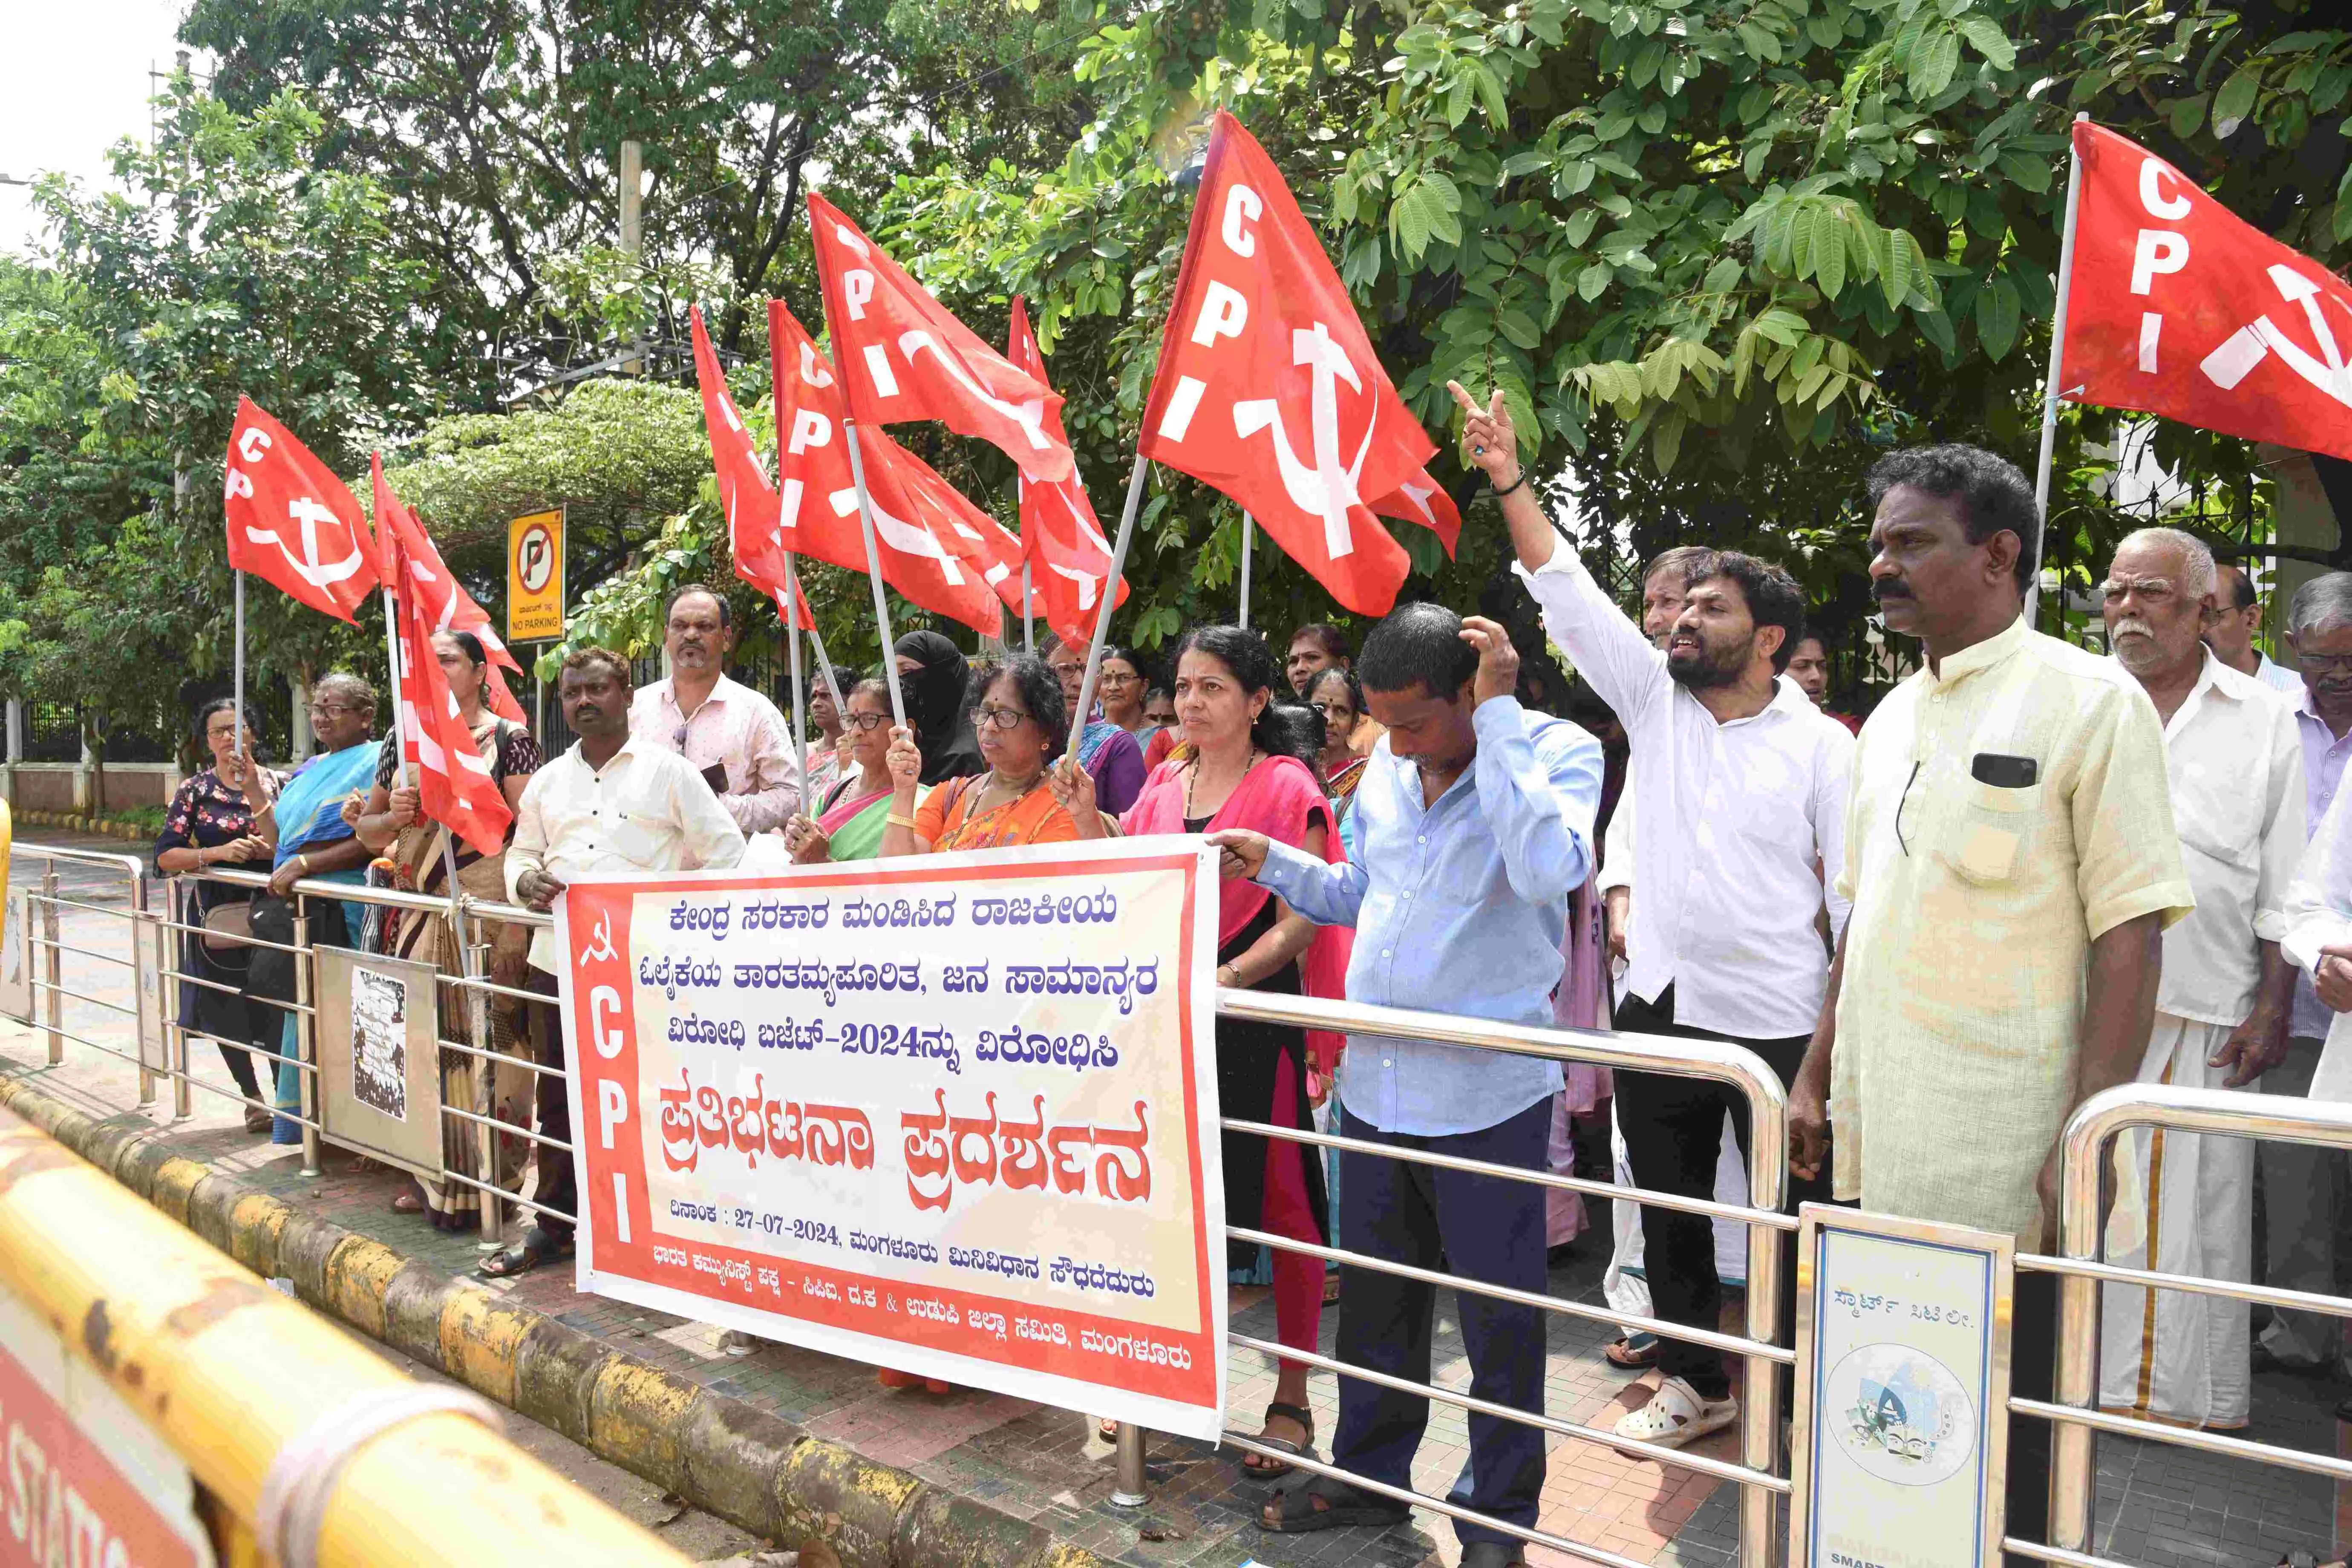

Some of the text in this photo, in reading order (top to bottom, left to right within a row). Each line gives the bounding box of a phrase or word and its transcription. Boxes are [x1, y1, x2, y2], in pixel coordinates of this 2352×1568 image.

[1158, 184, 1262, 443] CPI
[2130, 157, 2192, 374] CPI
[513, 617, 557, 631] NO PARKING
[670, 885, 1117, 941] ಕೇಂದ್ರ ಸರಕಾರ ಮಂಡಿಸಿದ ರಾಜಕೀಯ
[640, 954, 1159, 1015] ಓಲೈಕೆಯ ತಾರತಮ್ಯಪೂರಿತ, ಜನ ಸಾಮಾನ್ಯರ
[668, 1012, 1118, 1075] ವಿರೋಧಿ ಬಜೆಟ್-2024ನ್ನು ವಿರೋಧಿಸಿ
[590, 985, 631, 1244] CPI
[660, 1067, 1151, 1214] ಪ್ರತಿಭಟನಾ ಪ್ರದರ್ಶನ
[670, 1198, 717, 1223] ದಿನಾಂಕ
[735, 1208, 842, 1249] 27-07-2024,
[849, 1227, 938, 1263] ಮಂಗಳೂರು
[948, 1246, 1039, 1279] ಮಿನಿವಿಧಾನ
[1049, 1256, 1154, 1298] ಸೌಧದೆದುರು
[653, 1243, 688, 1267] ಭಾರತ
[757, 1265, 781, 1298] ಪಕ್ಷ
[803, 1275, 842, 1303] ಸಿಪಿಐ,
[847, 1282, 877, 1308] ದ.ಕ
[886, 1291, 898, 1314] &
[906, 1296, 960, 1324] ಉಡುಪಿ
[968, 1307, 1007, 1342] ಜಿಲ್ಲಾ
[1015, 1315, 1072, 1350] ಸಮಿತಿ,
[1080, 1327, 1192, 1370] ಮಂಗಳೂರು
